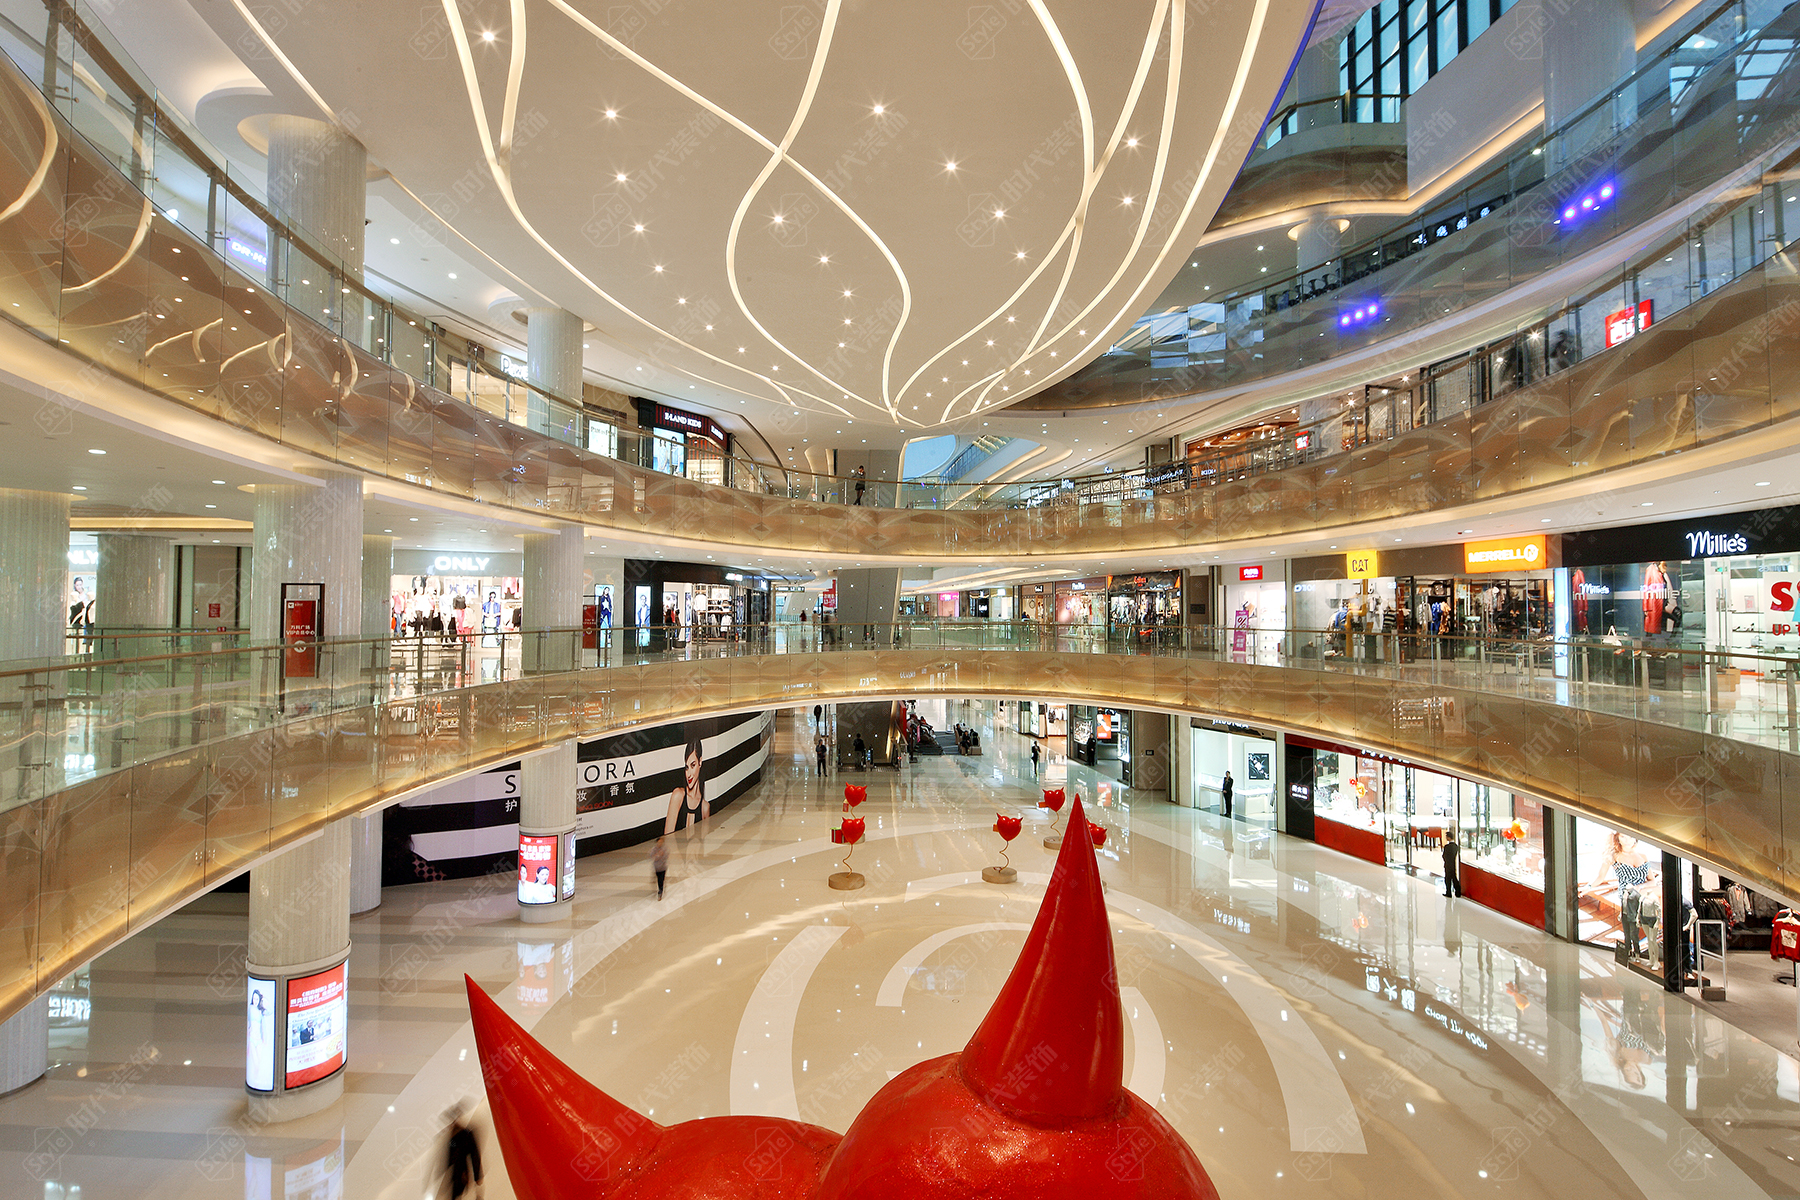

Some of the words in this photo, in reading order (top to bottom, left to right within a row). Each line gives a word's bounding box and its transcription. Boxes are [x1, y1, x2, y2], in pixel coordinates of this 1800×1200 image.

[1685, 530, 1748, 557] Millie's
[1468, 548, 1525, 563] MERRELL
[434, 556, 490, 571] ONLY
[1352, 558, 1369, 572] CAT
[1772, 624, 1791, 636] UP
